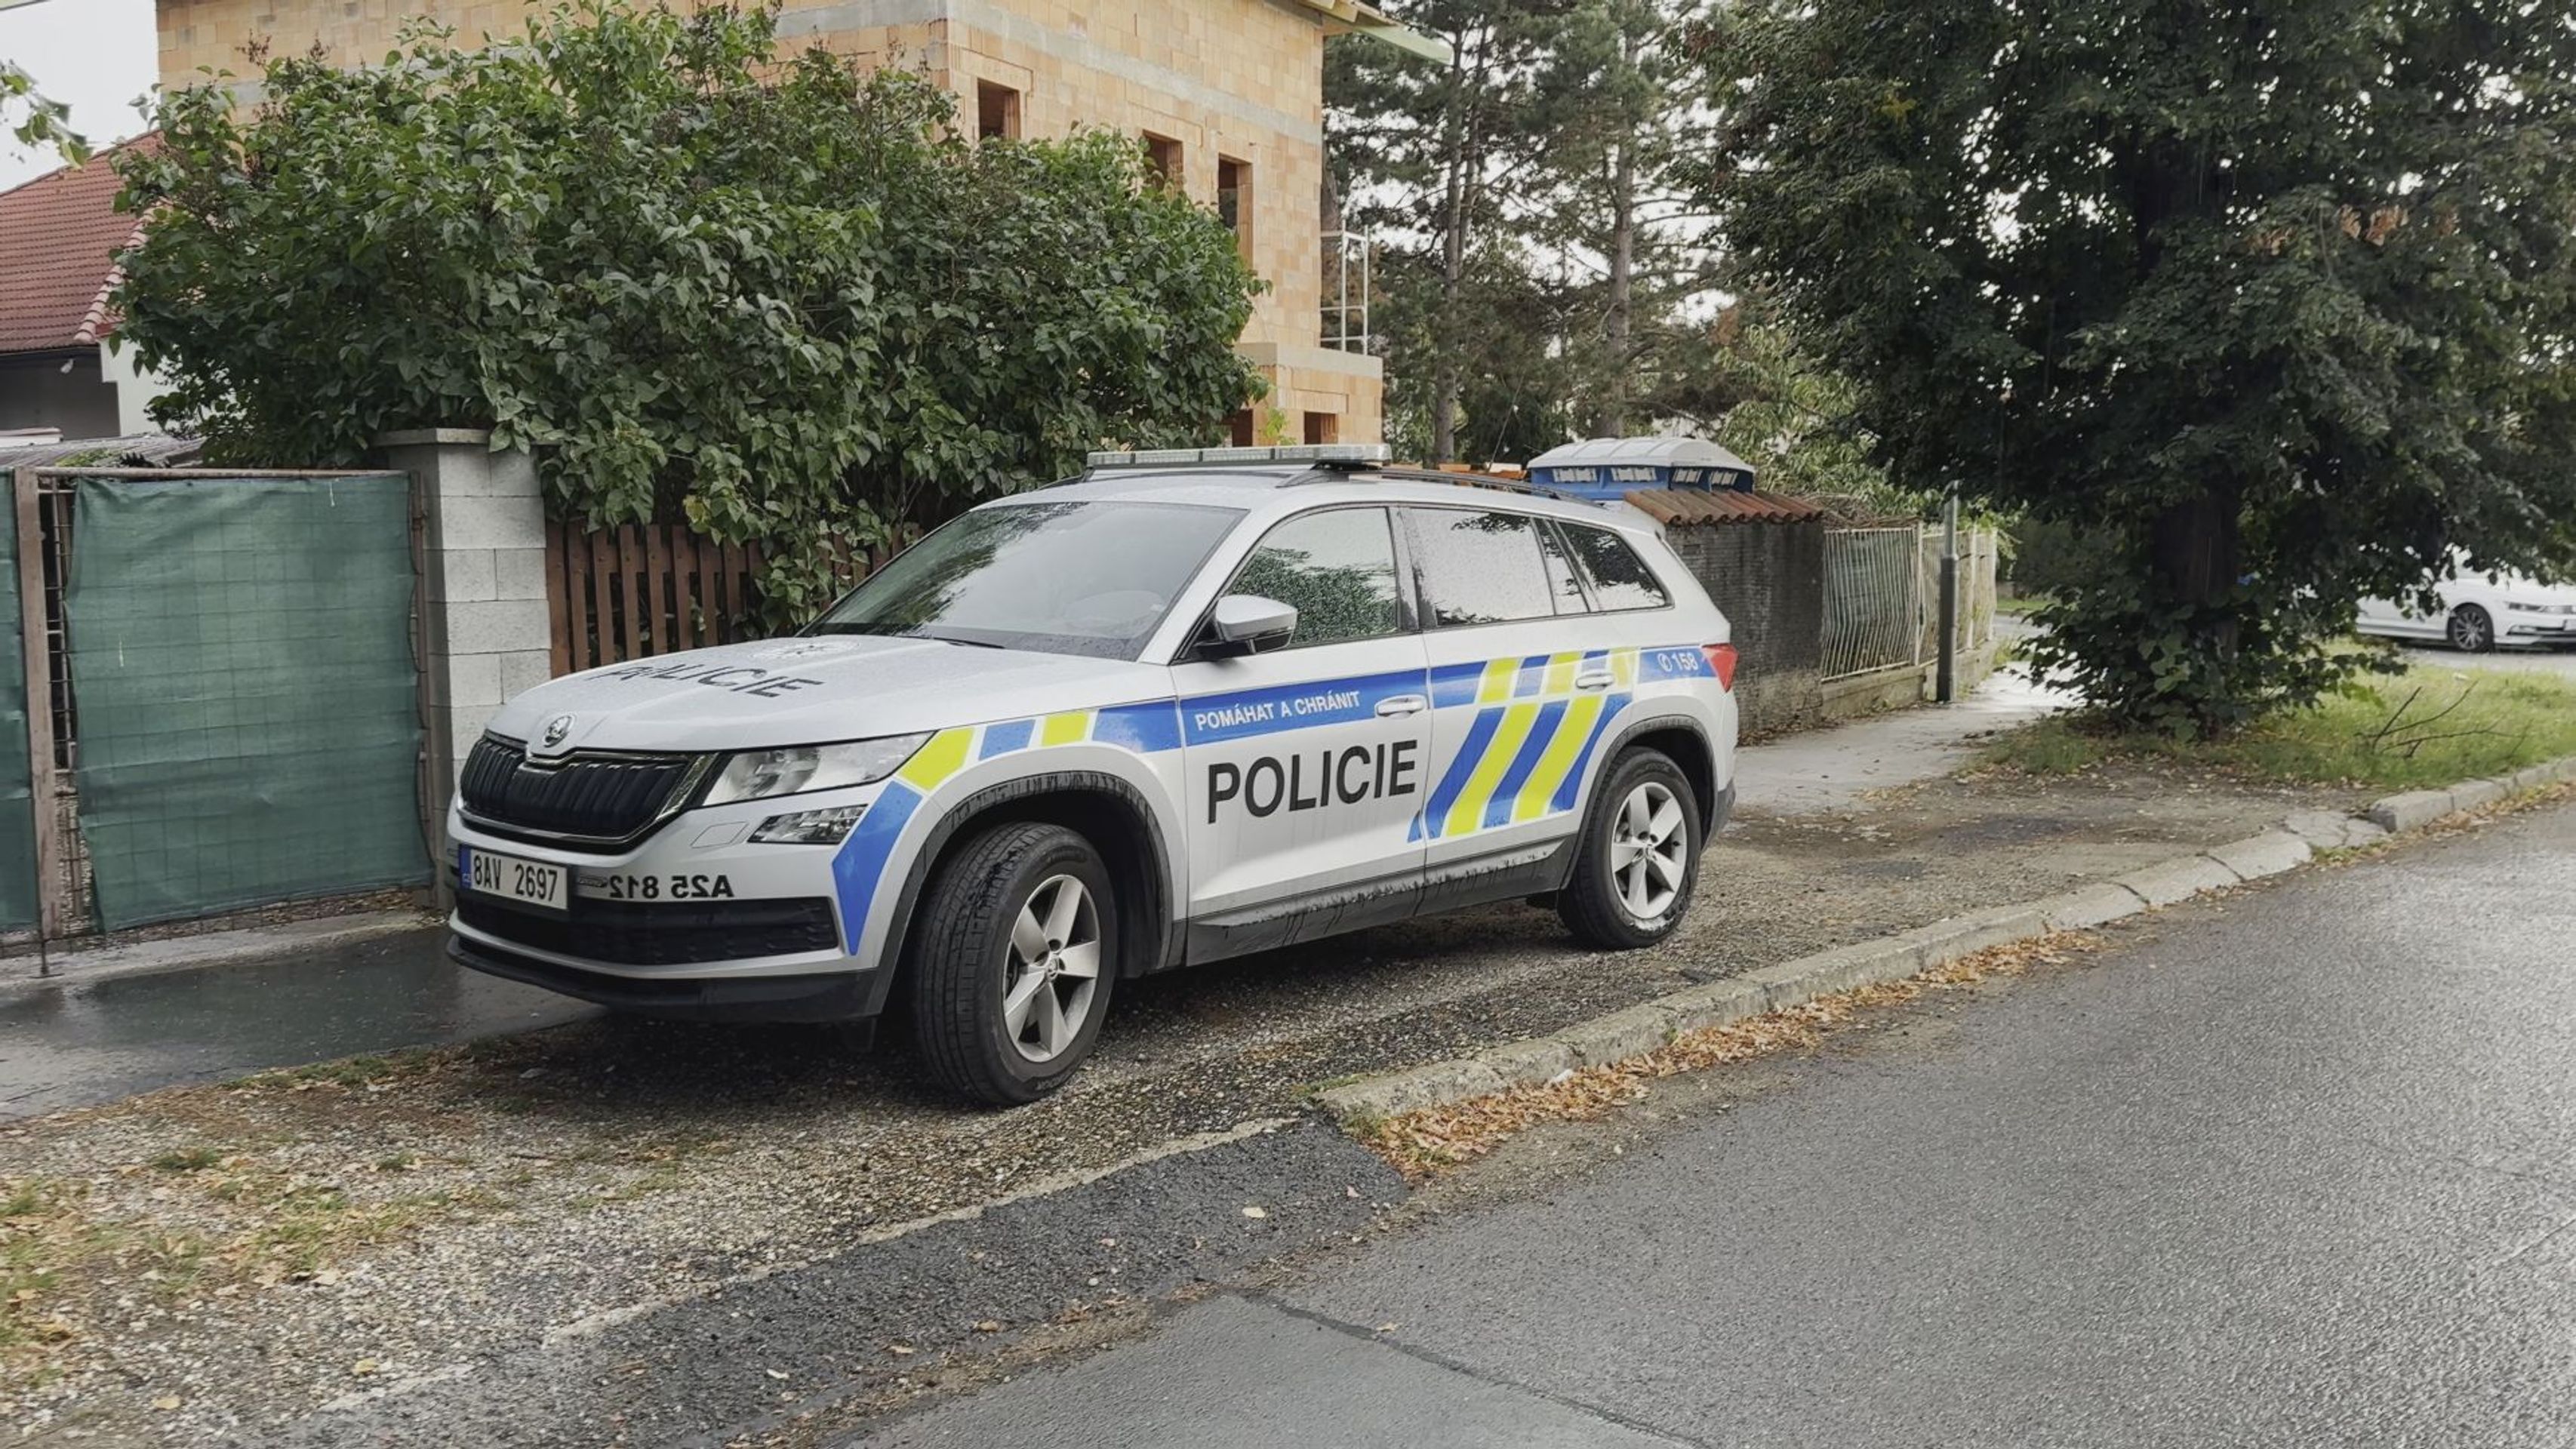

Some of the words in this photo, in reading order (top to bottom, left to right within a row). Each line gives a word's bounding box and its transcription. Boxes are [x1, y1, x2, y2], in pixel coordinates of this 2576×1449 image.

[1671, 652, 1698, 670] 158
[1195, 703, 1274, 731] POMÁHAT
[1281, 701, 1292, 718] A
[1294, 690, 1360, 715] CHRÁNIT
[1208, 740, 1417, 824] POLICIE
[473, 855, 502, 890] 8AV
[515, 863, 559, 901] 2697
